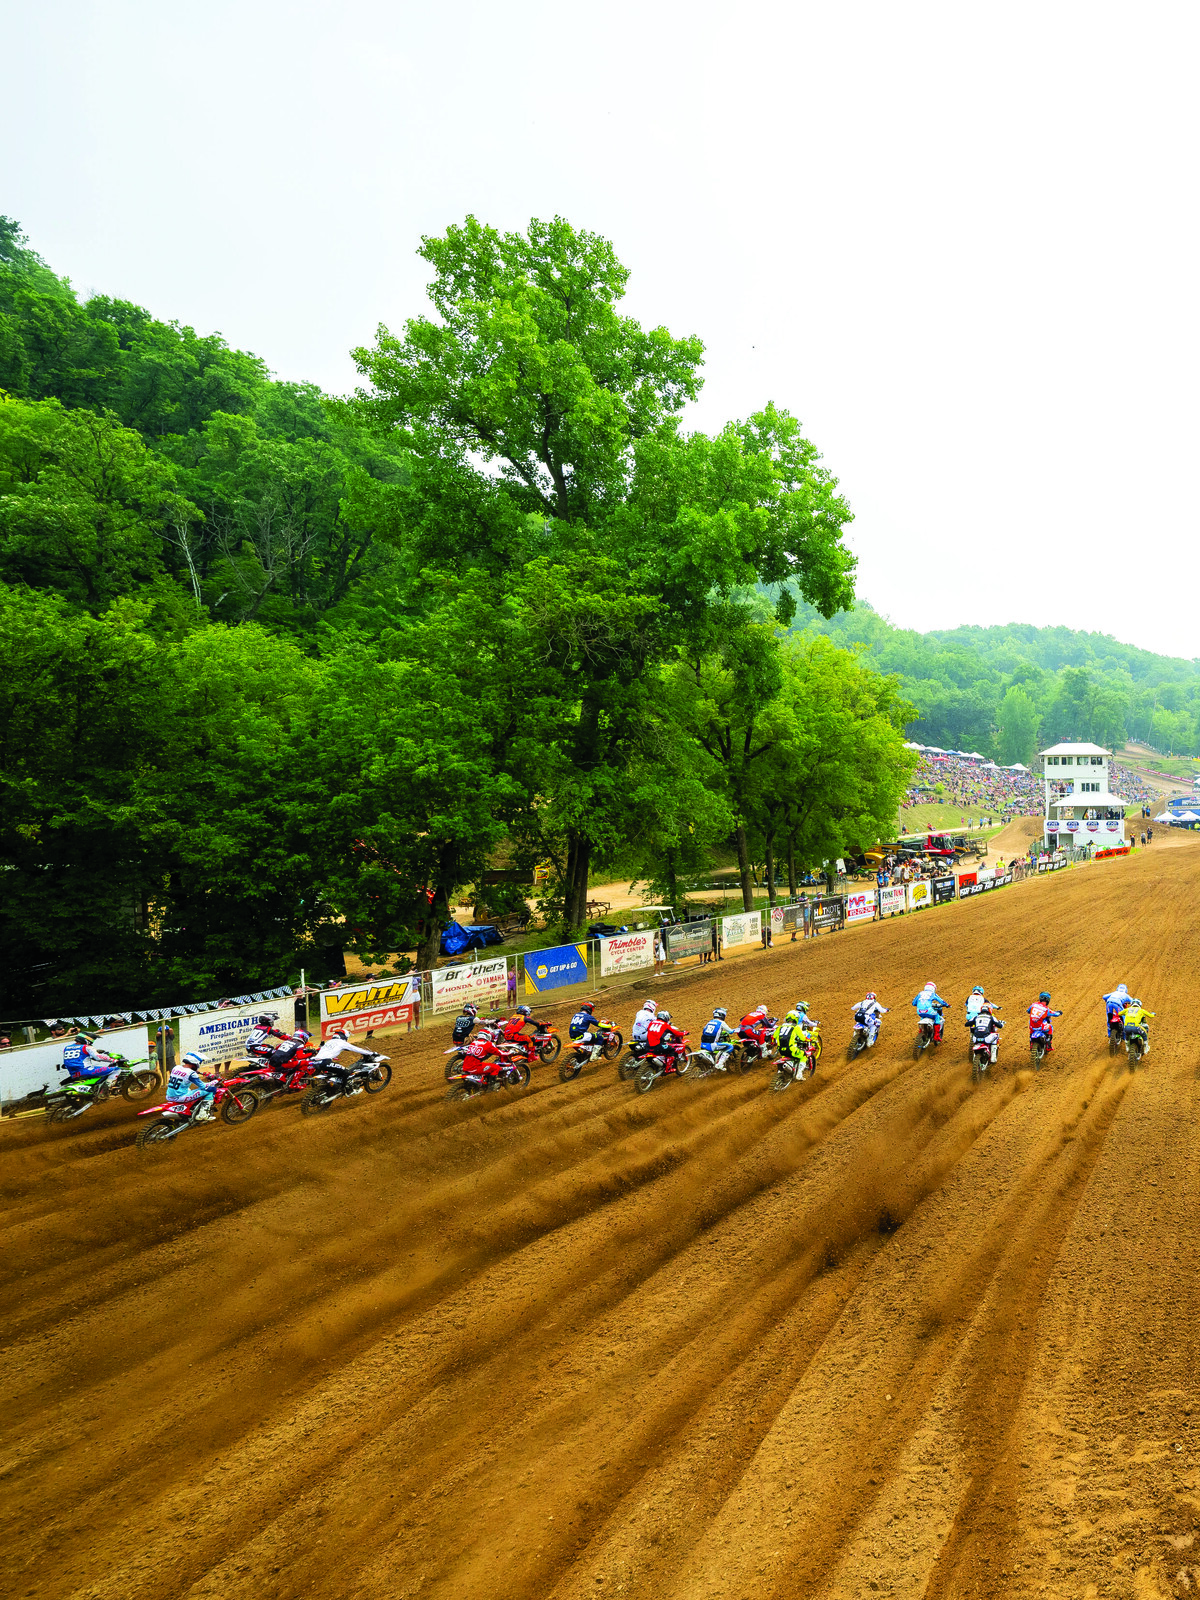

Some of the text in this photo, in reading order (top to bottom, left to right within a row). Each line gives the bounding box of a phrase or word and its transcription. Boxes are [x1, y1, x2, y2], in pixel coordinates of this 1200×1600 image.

[608, 936, 646, 951] Trimble's
[625, 946, 644, 954] CENTER
[550, 965, 558, 973] GET
[482, 974, 504, 984] YAMAHA
[445, 983, 472, 992] HONDA
[324, 982, 409, 1015] VAITH
[198, 1017, 248, 1036] AMERICAN
[325, 1008, 410, 1036] GASGAS
[210, 1030, 234, 1040] Fireplace
